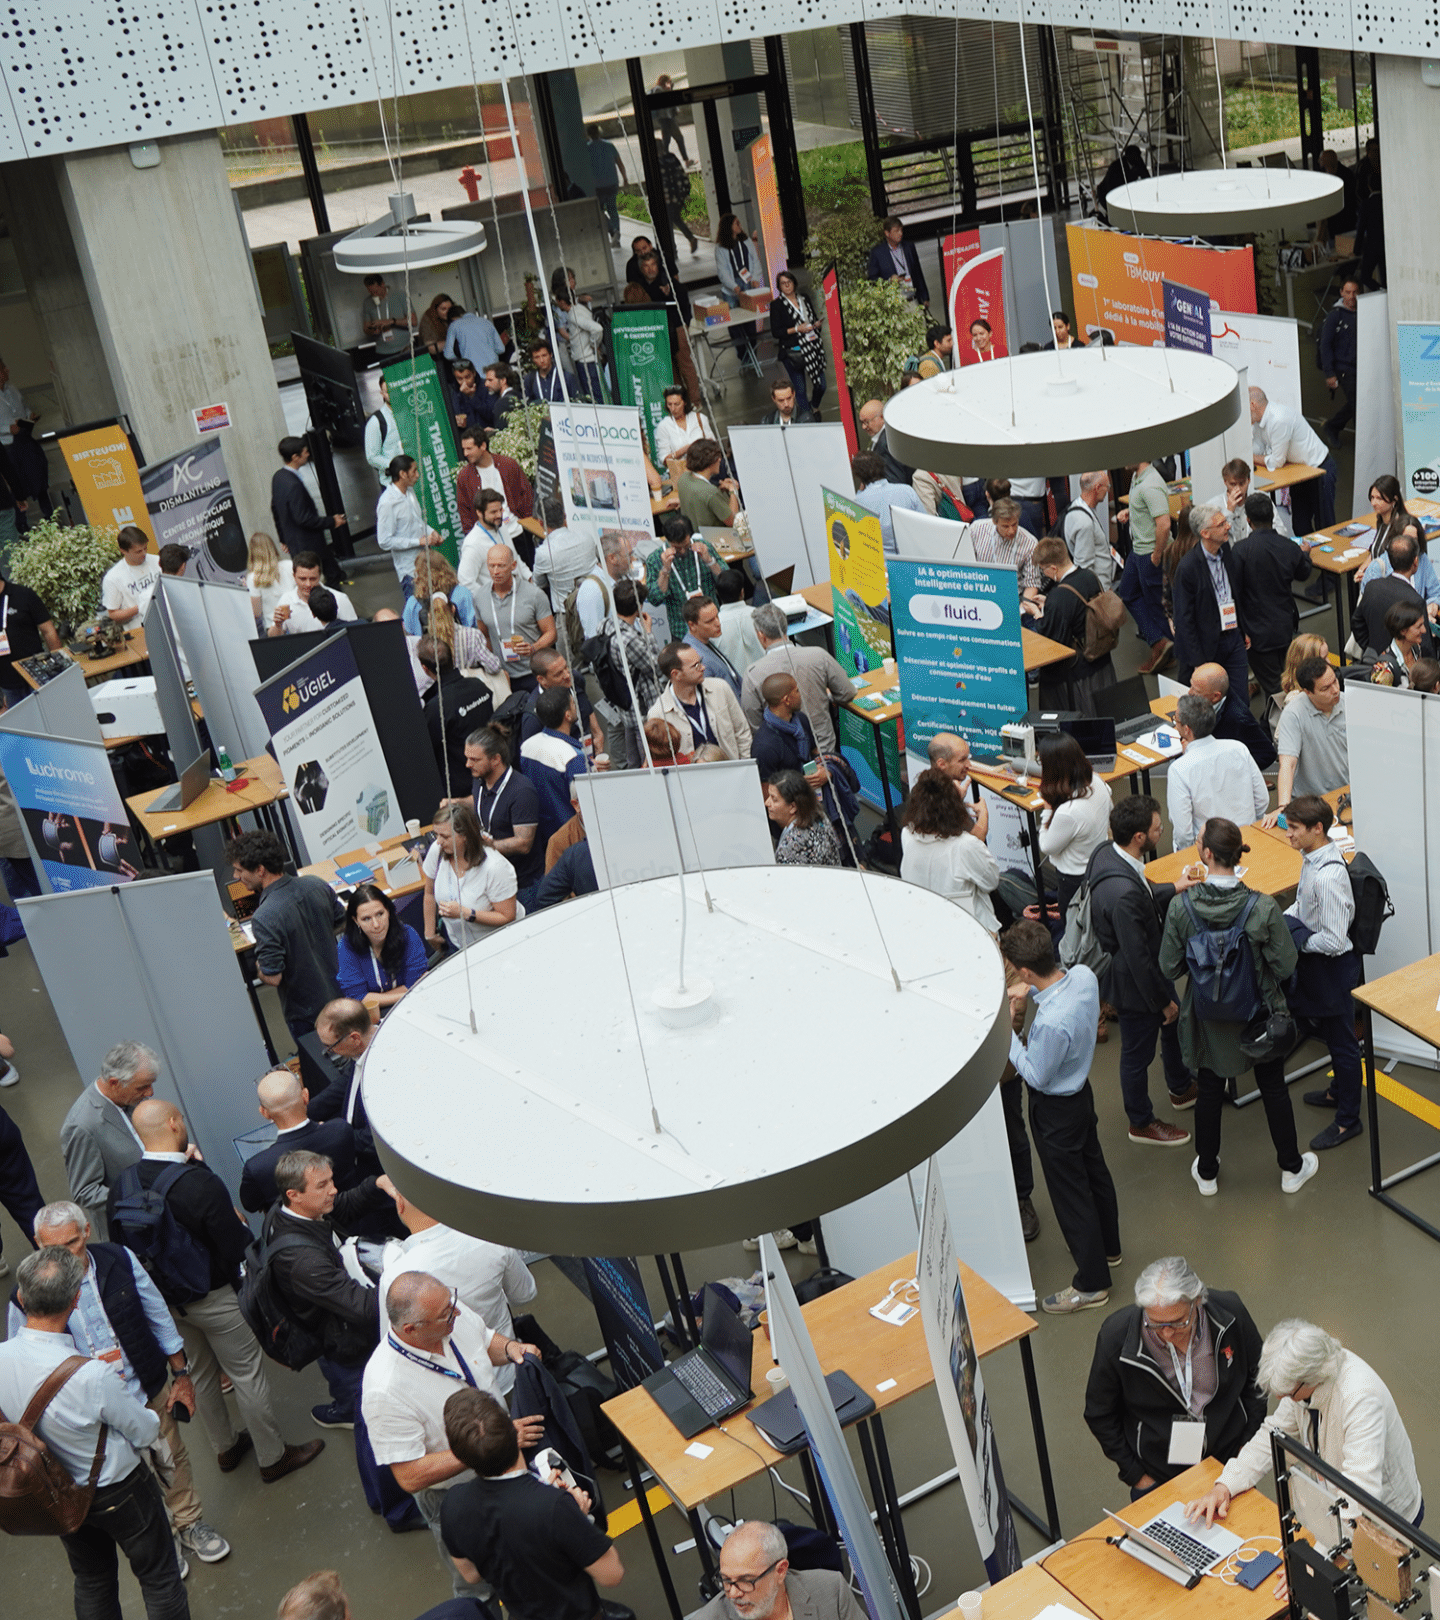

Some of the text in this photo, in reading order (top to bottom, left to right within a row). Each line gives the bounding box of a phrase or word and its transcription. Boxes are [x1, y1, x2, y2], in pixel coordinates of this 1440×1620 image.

[1111, 299, 1149, 316] laboratoire
[1104, 311, 1123, 323] dédié
[1131, 316, 1138, 326] la
[613, 325, 664, 334] ENVIRONNEMENT
[173, 455, 203, 495] AC
[1413, 471, 1439, 480] +100
[159, 476, 222, 513] DISMANTLING
[162, 499, 232, 540] CENTRE DE RECYCLAGE
[918, 567, 989, 582] IA & optimisation
[963, 582, 974, 591] de
[975, 582, 998, 594] l'EAU
[944, 604, 982, 622] fluid.
[897, 628, 916, 637] Suivre
[925, 632, 945, 641] temps
[959, 635, 970, 643] vos
[971, 637, 1021, 648] consommations
[903, 656, 938, 667] Déterminer
[946, 660, 975, 672] optimiser
[976, 664, 987, 672] vos
[988, 666, 1008, 675] profils
[929, 669, 992, 683] consommation d'eau
[299, 670, 336, 703] UGIEL
[332, 699, 356, 721] SOLUTIONS
[911, 693, 937, 703] Détecter
[938, 696, 986, 709] immédiatement
[997, 703, 1016, 713] fuites
[917, 720, 953, 731] Certification
[963, 732, 969, 740] &
[25, 757, 95, 785] Luchrome
